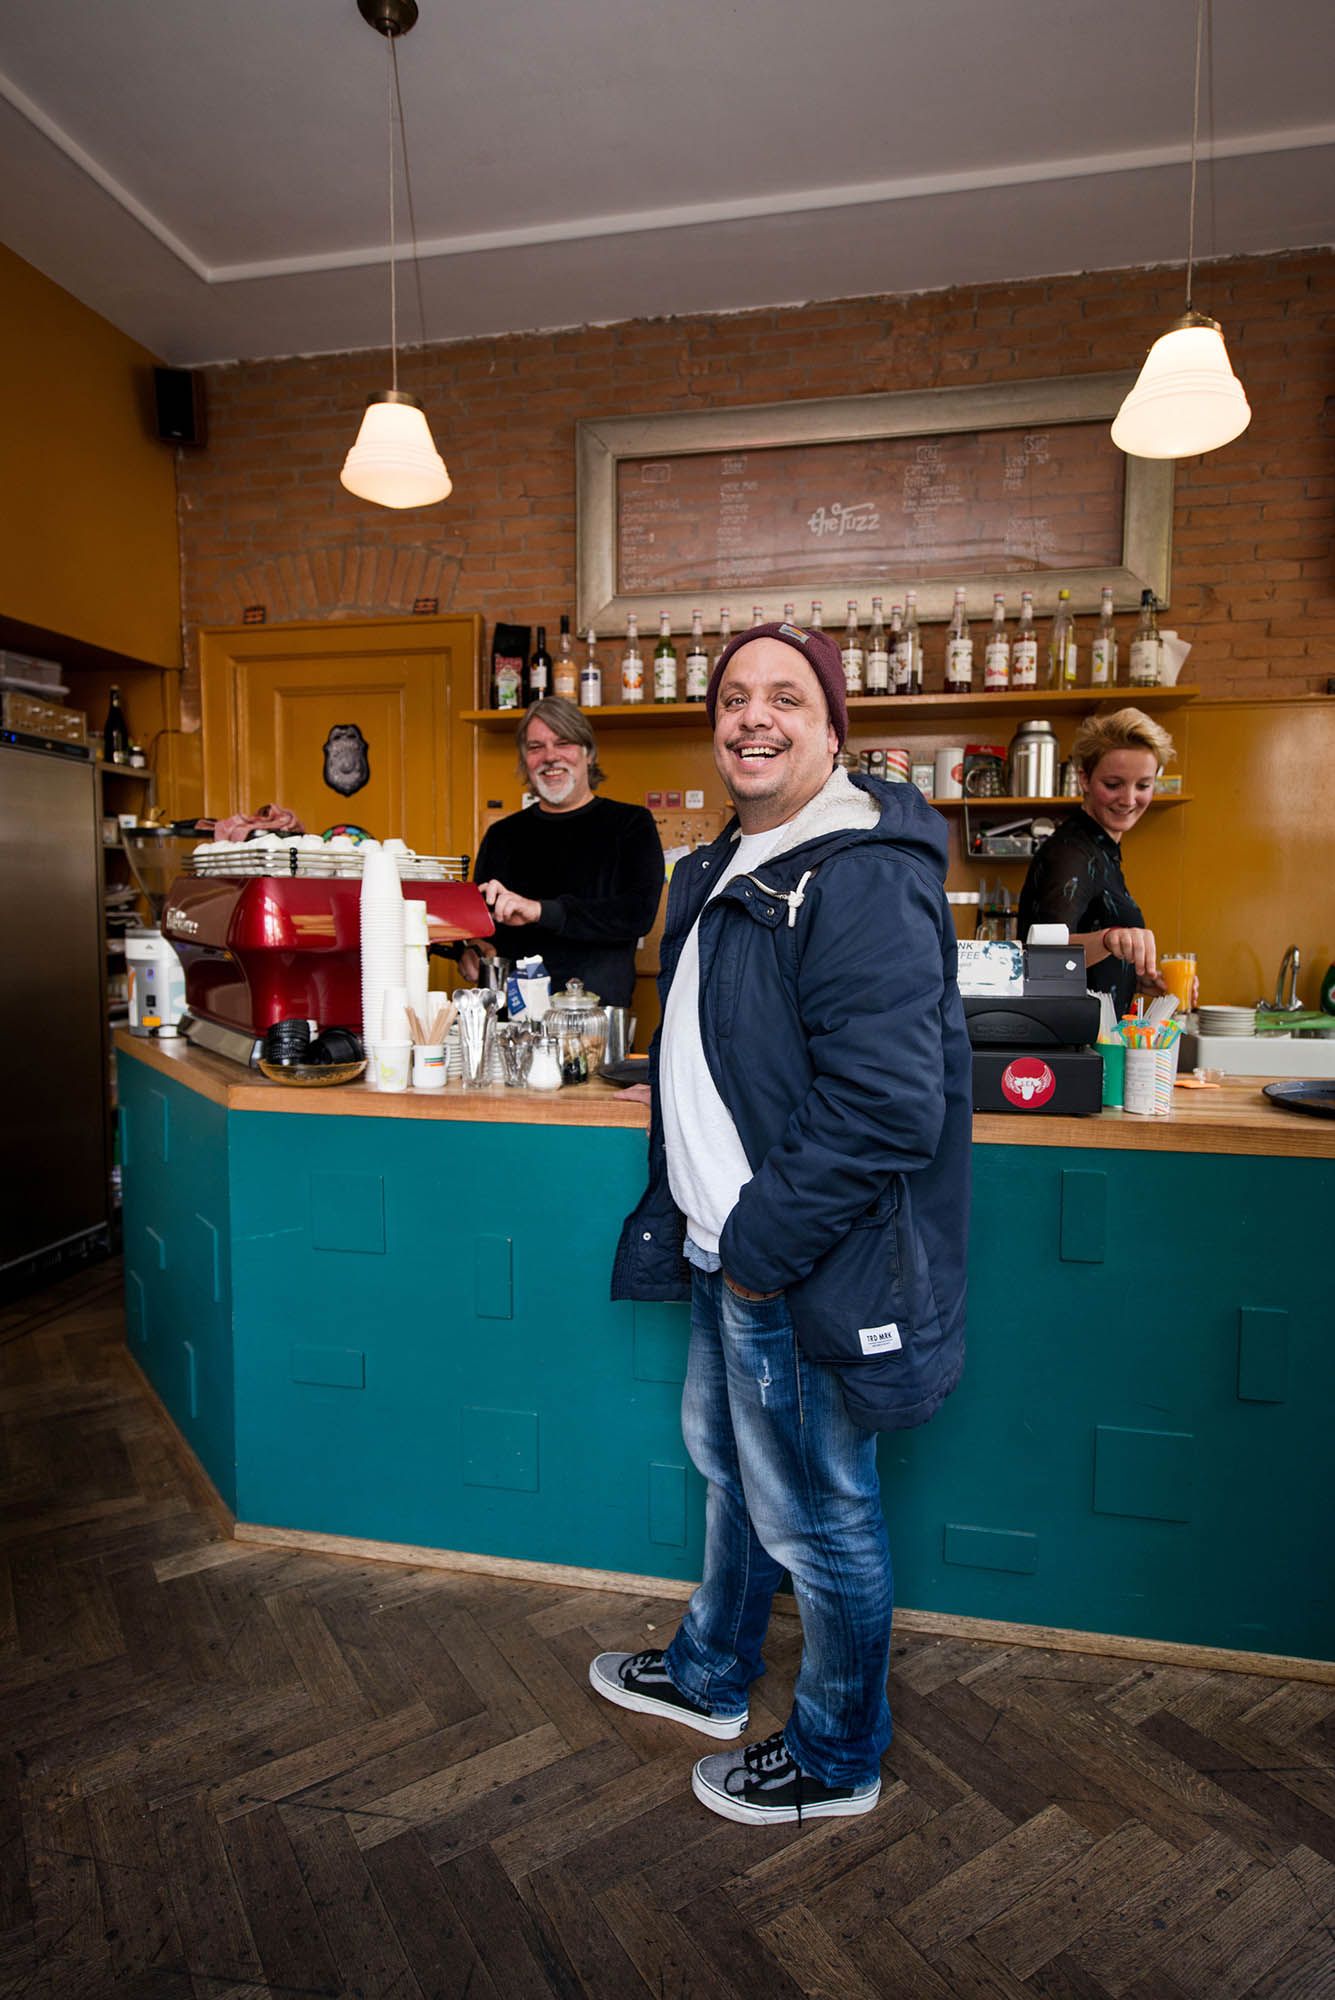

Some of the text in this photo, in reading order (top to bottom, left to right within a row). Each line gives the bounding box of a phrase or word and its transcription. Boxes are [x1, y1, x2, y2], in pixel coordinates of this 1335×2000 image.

[831, 502, 881, 537] Fuzz
[958, 951, 981, 960] FEE
[866, 1334, 878, 1342] TRD
